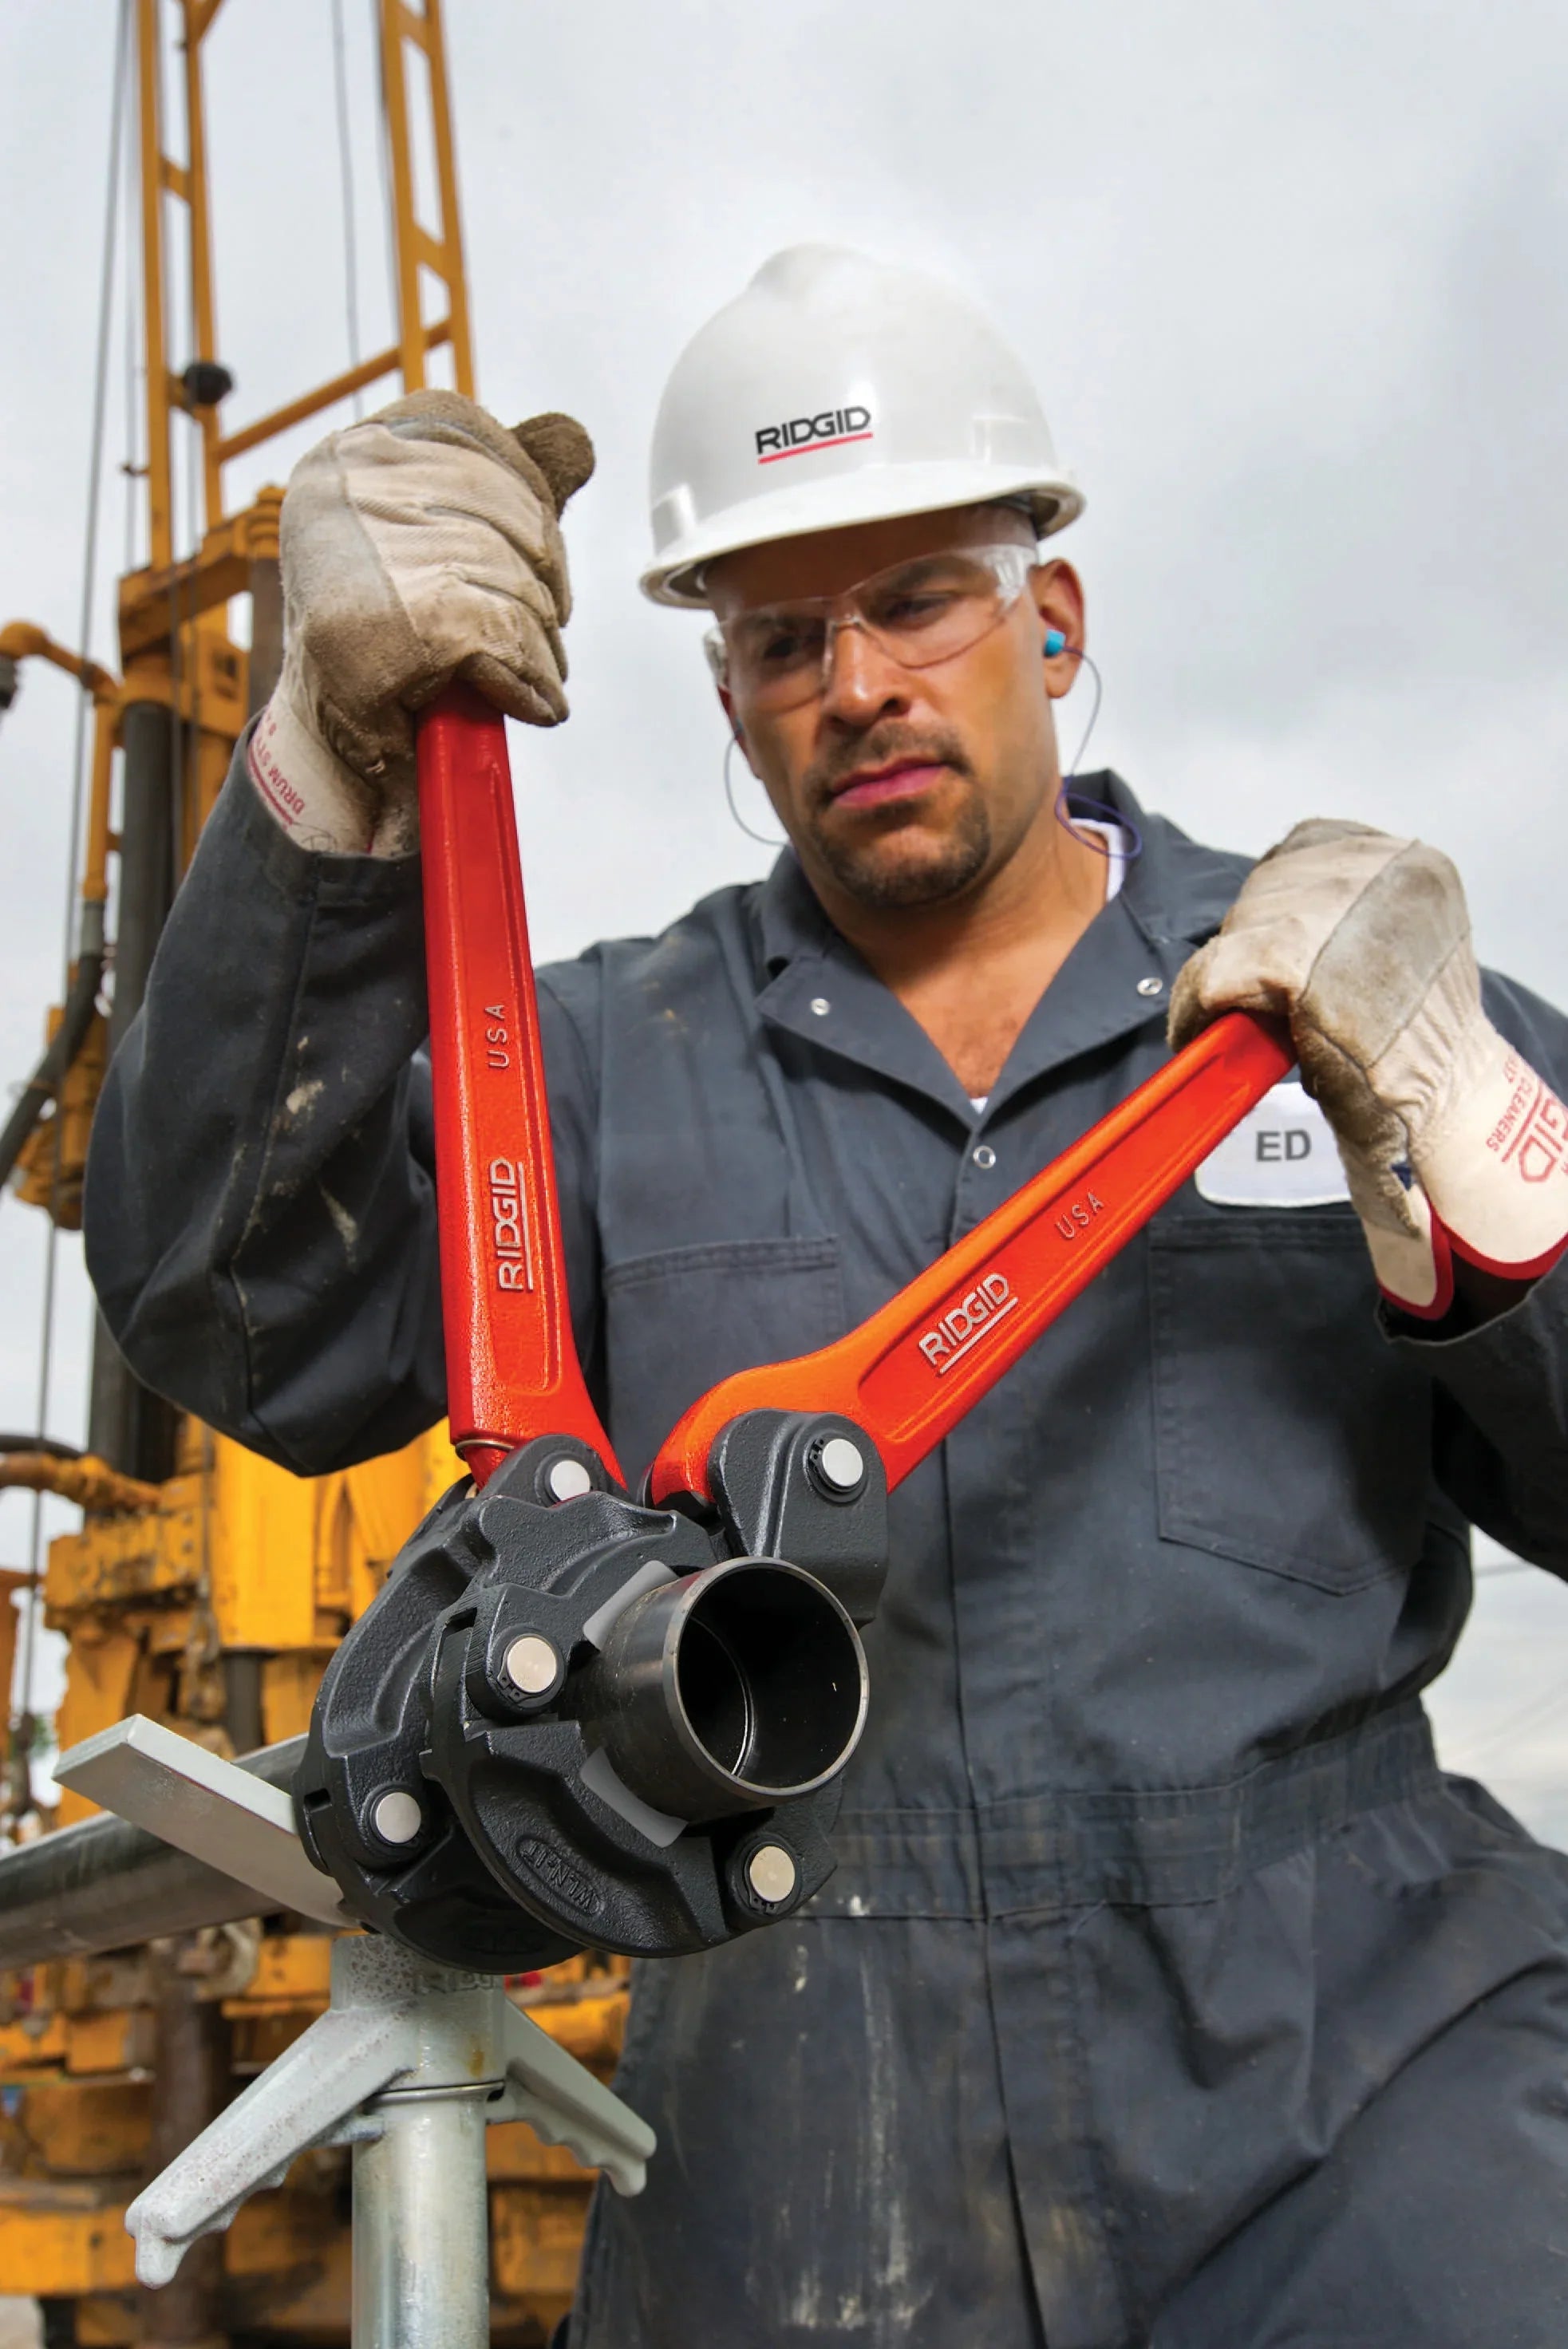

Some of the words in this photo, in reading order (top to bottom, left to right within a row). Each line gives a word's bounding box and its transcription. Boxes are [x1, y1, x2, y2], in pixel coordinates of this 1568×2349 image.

[755, 405, 871, 455] RIDGID
[484, 1004, 510, 1070] USA
[1255, 1129, 1312, 1163] ED
[489, 1157, 524, 1290] RIDGID
[1056, 1191, 1105, 1239] USA
[918, 1273, 1010, 1365] RIDGID
